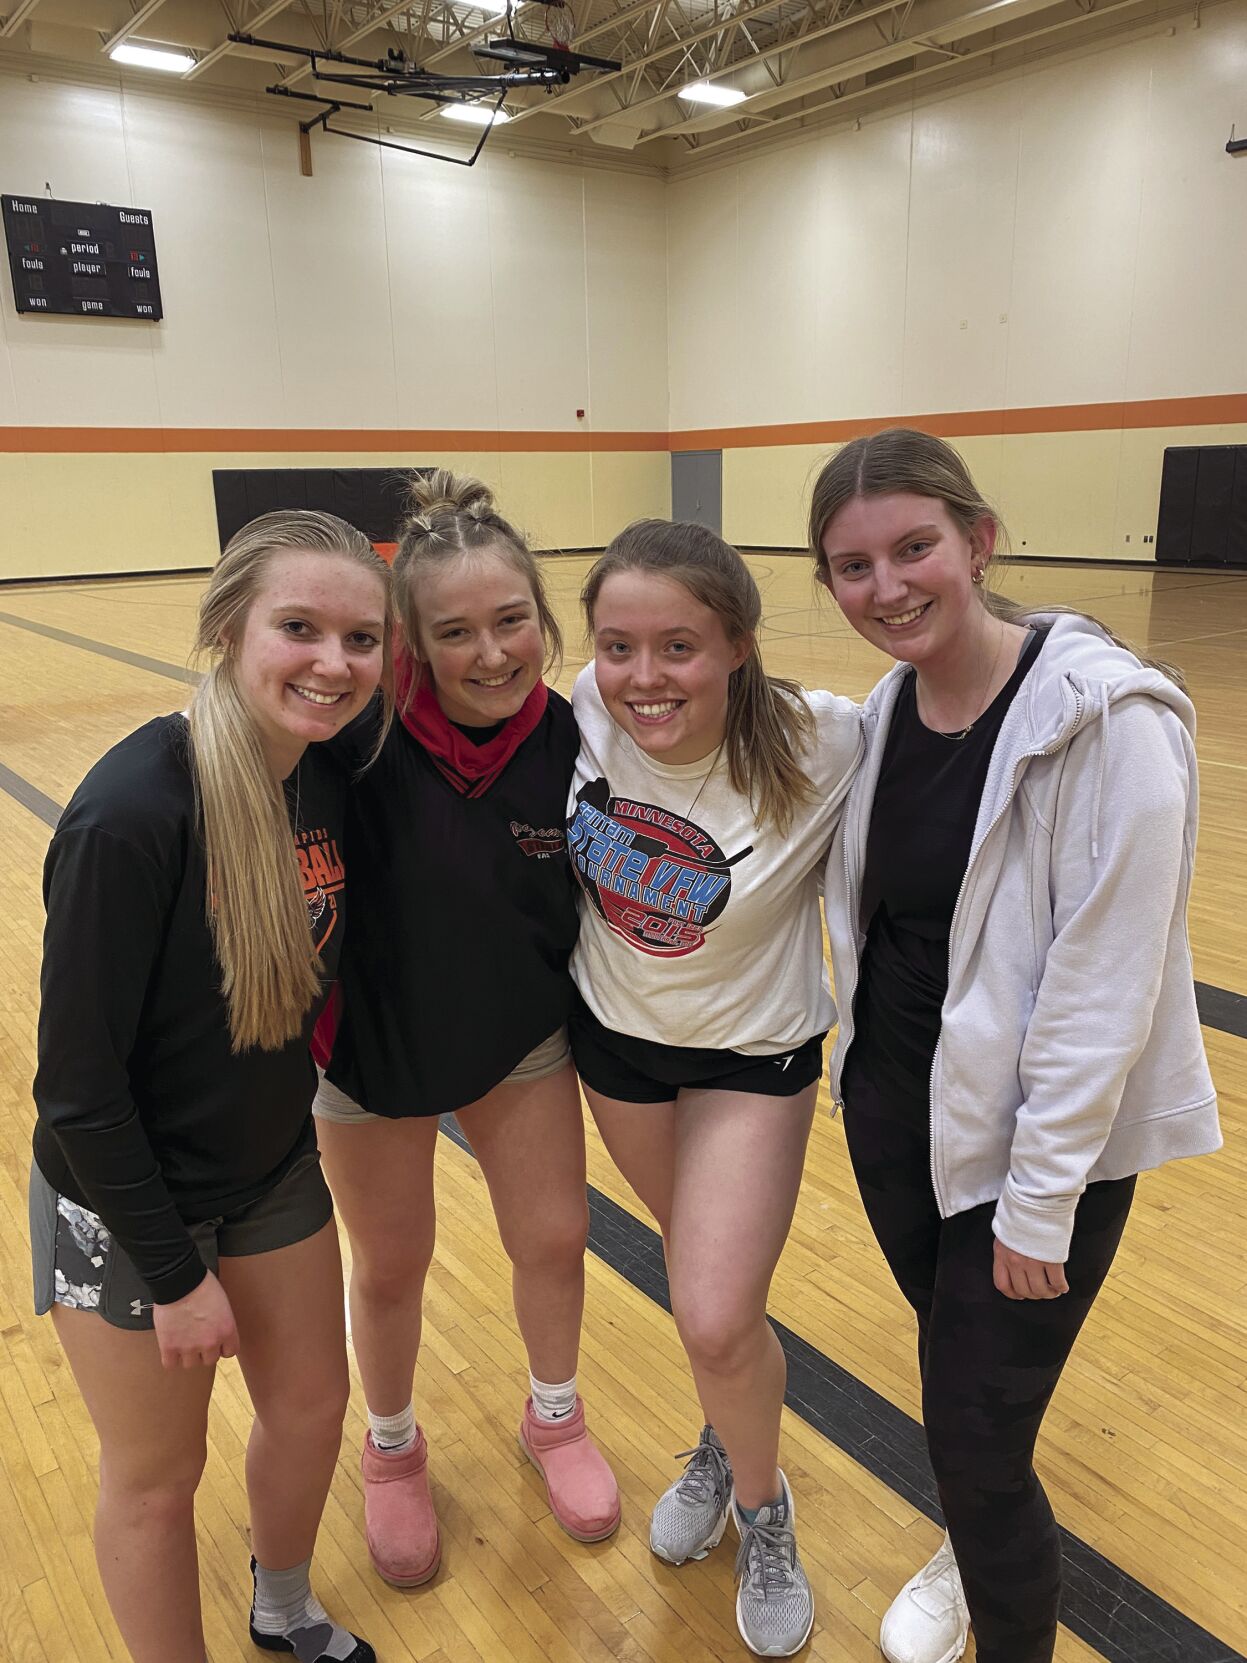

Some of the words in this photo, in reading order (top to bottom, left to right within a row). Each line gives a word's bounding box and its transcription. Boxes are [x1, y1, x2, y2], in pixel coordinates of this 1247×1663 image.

[12, 200, 37, 214] Home
[120, 211, 149, 224] Guests
[71, 243, 99, 254] period
[22, 257, 44, 269] fouls
[73, 262, 101, 274] player
[131, 266, 151, 278] fouls
[29, 298, 47, 307] won
[82, 301, 103, 311] game
[137, 305, 153, 314] won
[614, 800, 715, 859] MINNESOTA
[572, 851, 707, 924] OURNAMENT
[651, 860, 730, 906] VFW
[621, 907, 701, 942] 2015
